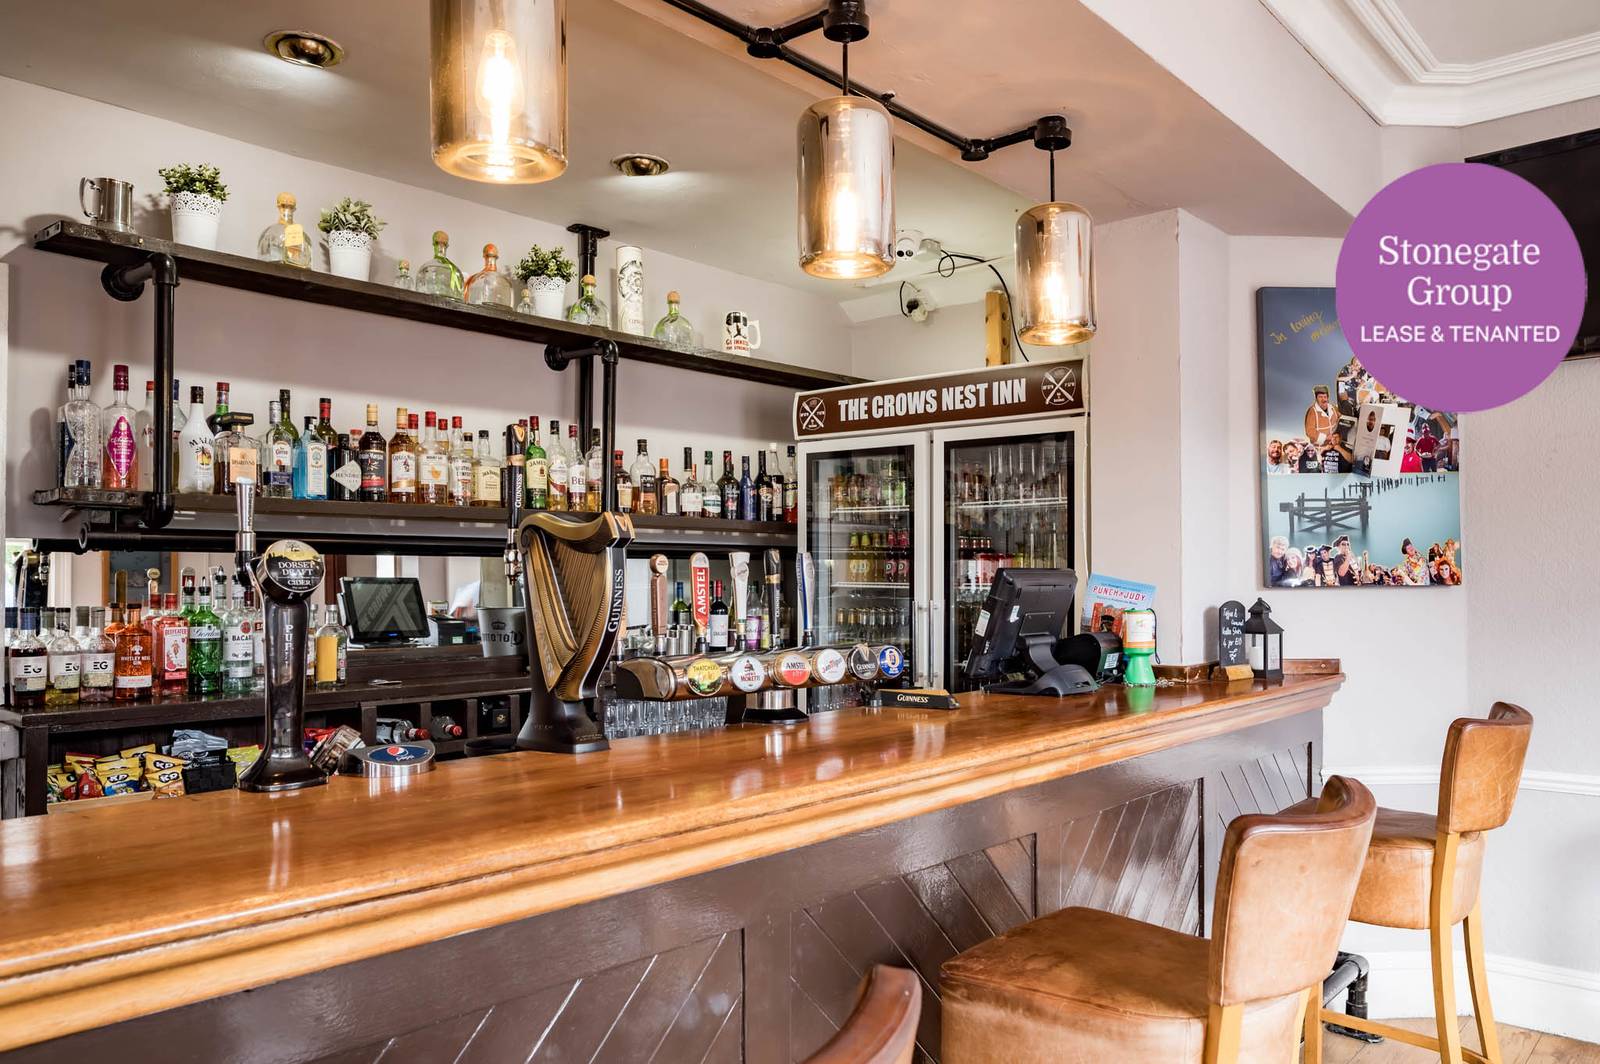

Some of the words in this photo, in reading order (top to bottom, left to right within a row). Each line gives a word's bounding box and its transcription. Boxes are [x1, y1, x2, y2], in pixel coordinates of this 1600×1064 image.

[838, 397, 869, 422] THE
[871, 389, 938, 419] CROWS
[941, 382, 989, 412] NEST
[992, 378, 1027, 406] INN
[514, 473, 523, 508] GUINNESS
[278, 561, 314, 569] DORSET
[282, 568, 314, 576] DRAFT
[696, 568, 707, 616] AMSTEL
[1093, 585, 1119, 597] PUNCH
[1123, 591, 1147, 601] JUDY
[607, 568, 624, 633] GUINNESS
[93, 661, 109, 670] EG
[785, 662, 806, 670] AMSTEL
[897, 693, 929, 704] GUINNESS
[108, 774, 128, 783] KP
[160, 772, 180, 782] KP
